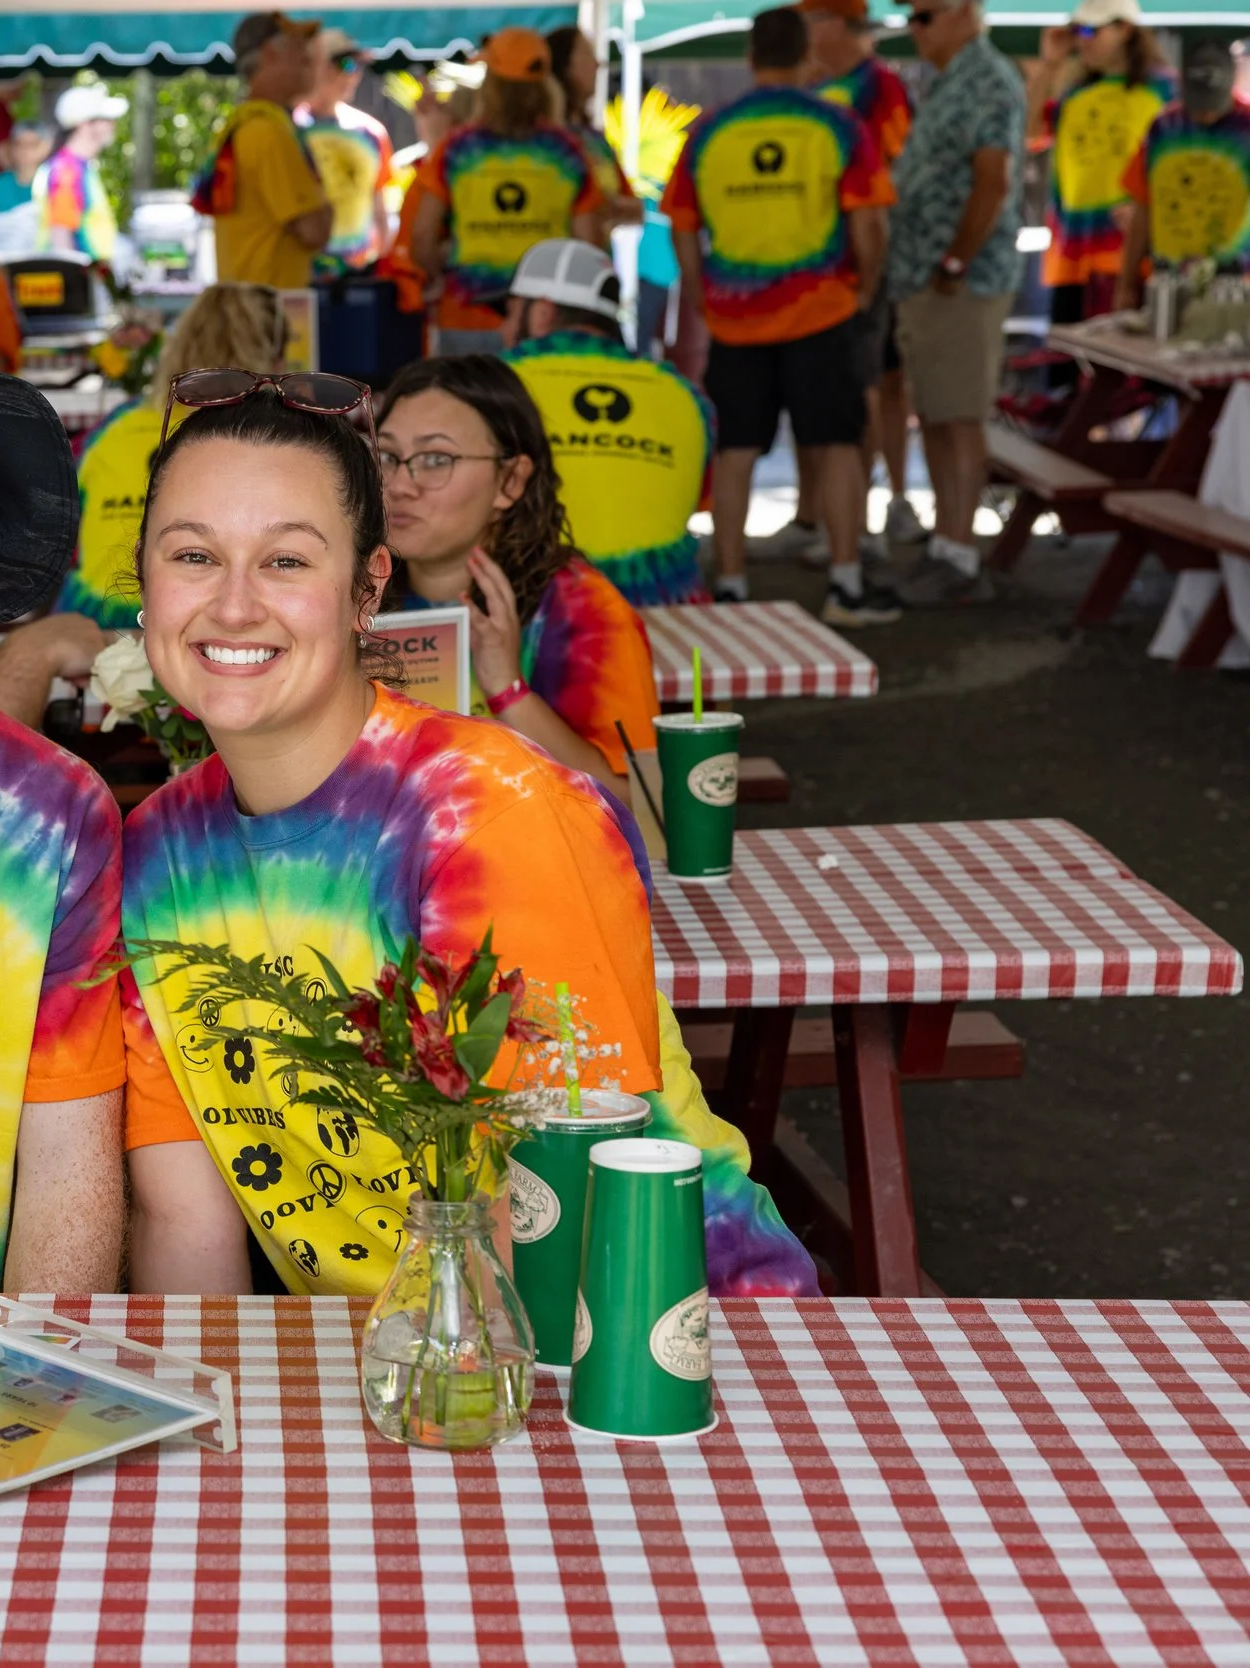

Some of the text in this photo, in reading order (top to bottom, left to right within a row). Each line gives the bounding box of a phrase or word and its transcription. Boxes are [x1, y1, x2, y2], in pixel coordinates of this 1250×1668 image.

[549, 432, 675, 457] ANCOCK
[235, 1107, 286, 1130] VIBES
[260, 1191, 336, 1231] OOVY
[0, 1391, 27, 1405] YEARS
